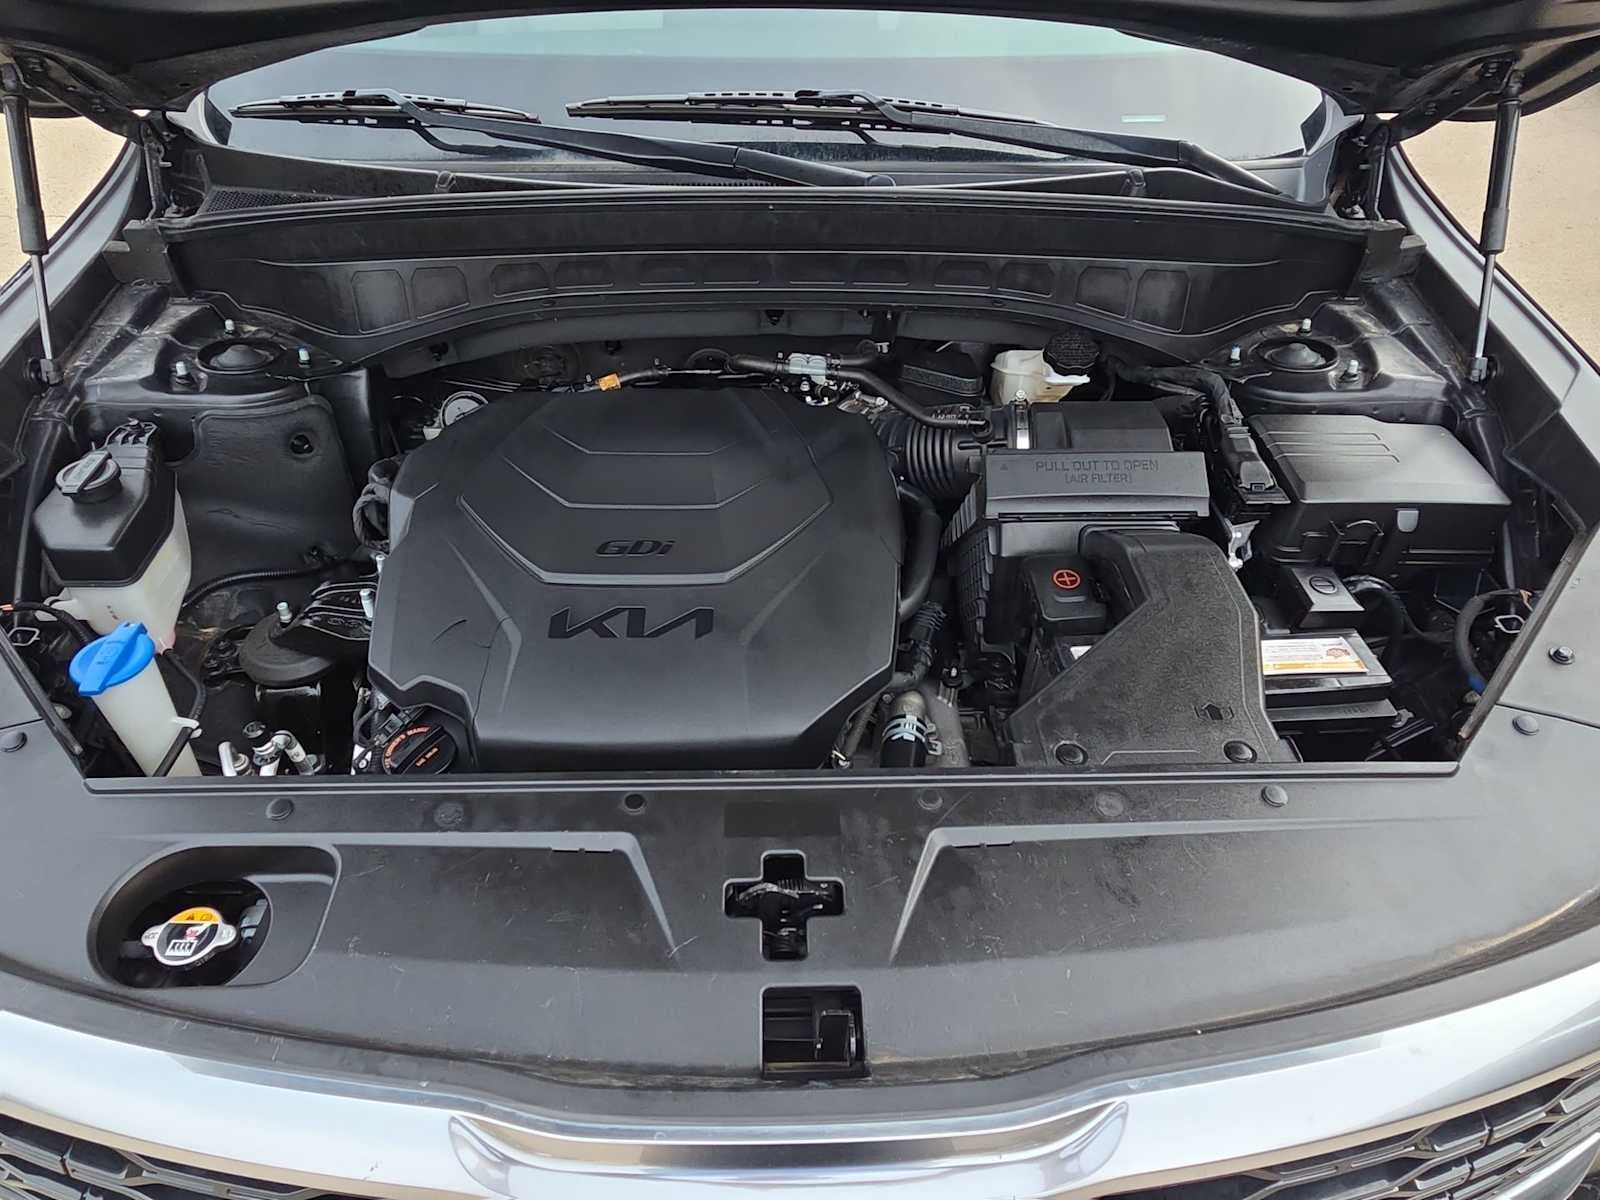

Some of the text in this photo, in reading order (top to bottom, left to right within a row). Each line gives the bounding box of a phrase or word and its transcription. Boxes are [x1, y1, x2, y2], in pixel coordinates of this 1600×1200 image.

[1035, 459, 1159, 472] PULL OUT TO OPEN
[595, 539, 676, 556] GDi
[548, 605, 714, 640] KIA
